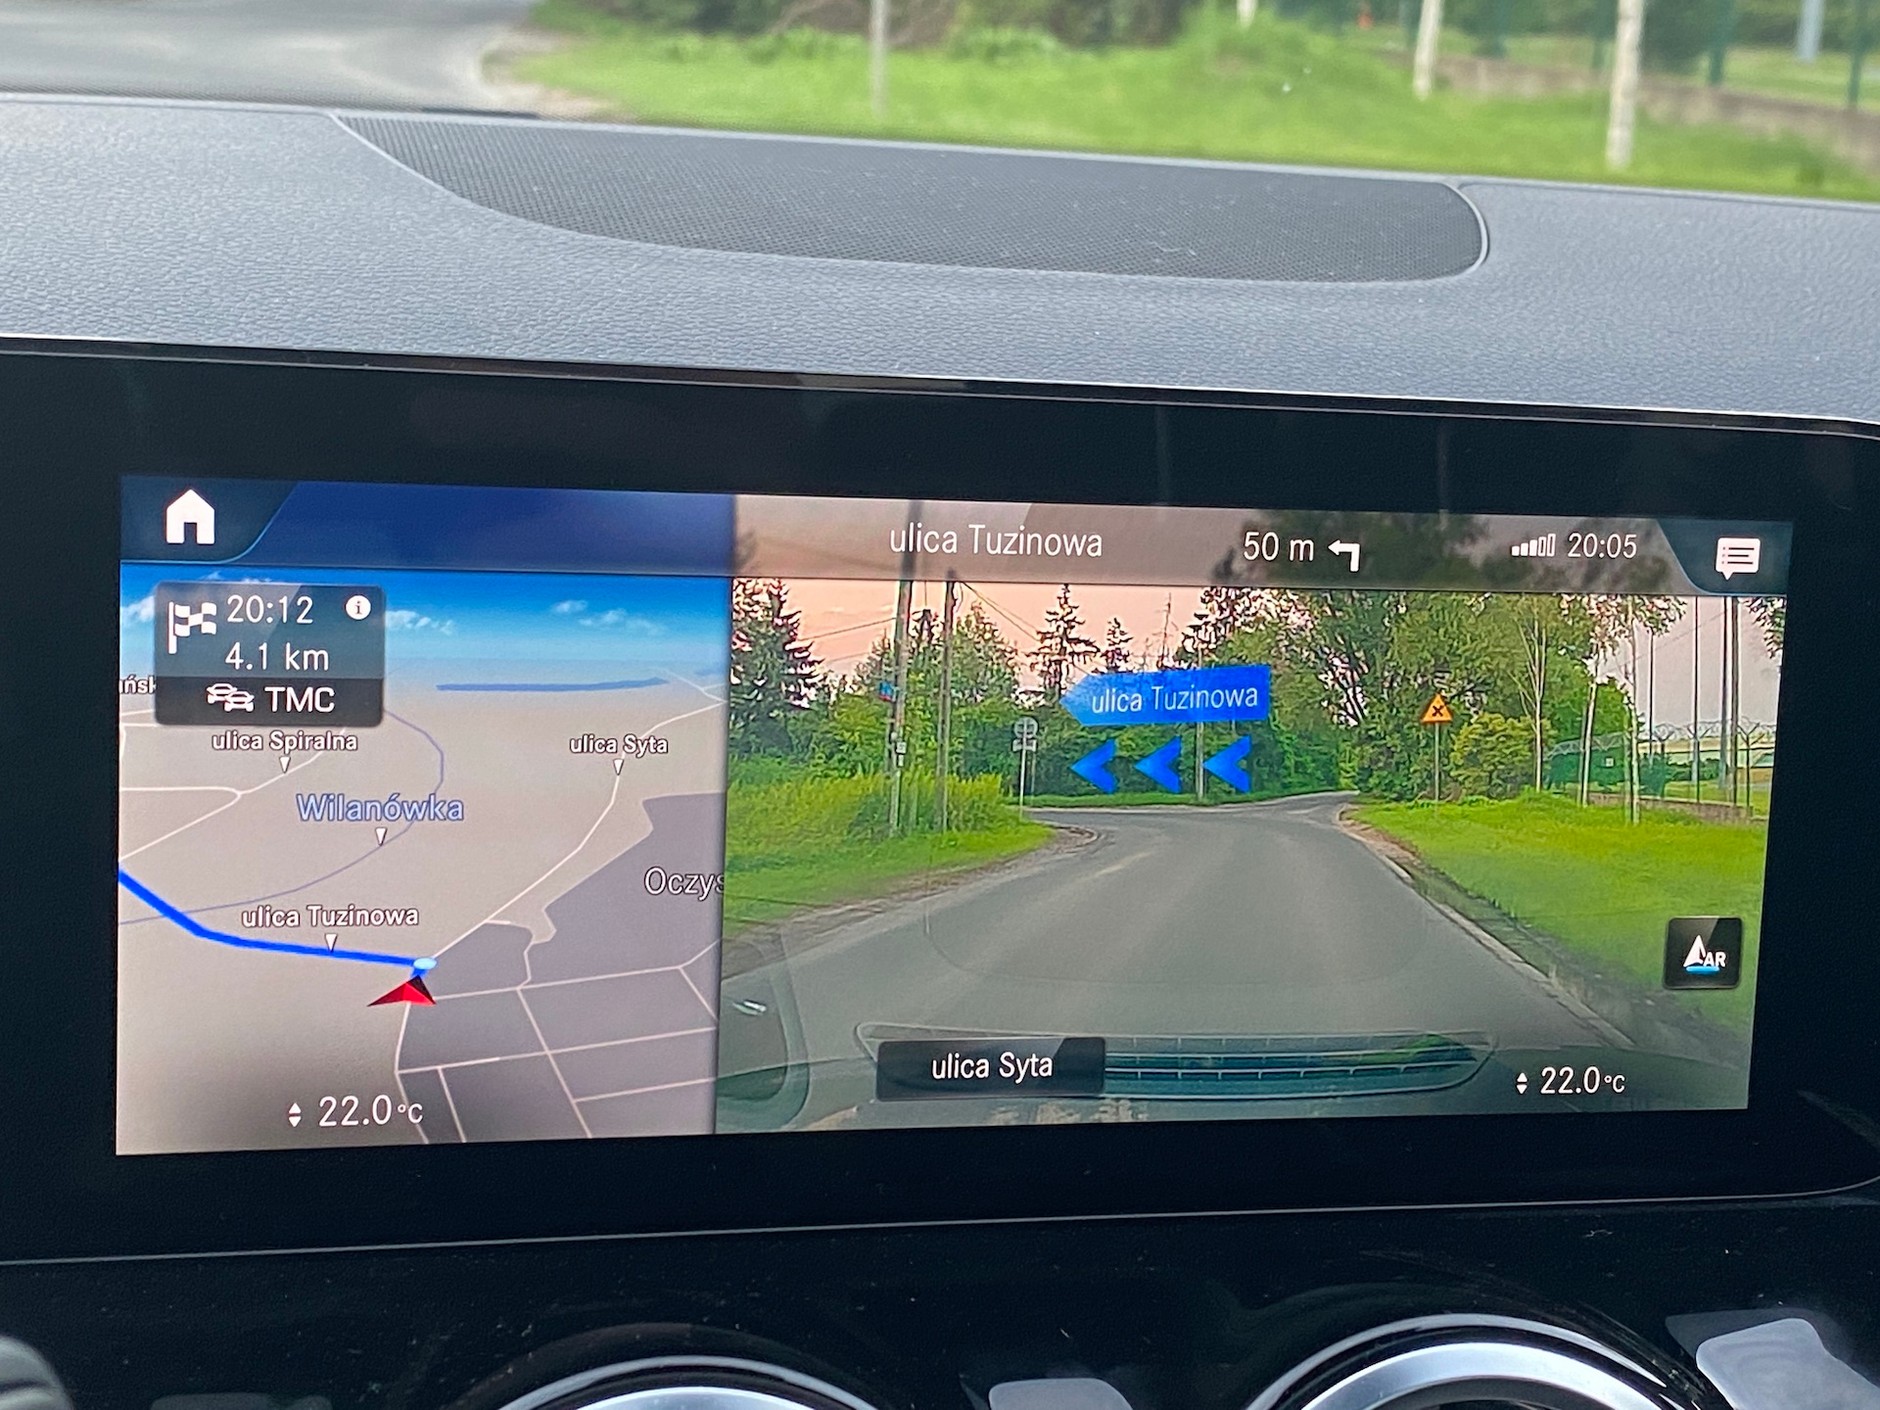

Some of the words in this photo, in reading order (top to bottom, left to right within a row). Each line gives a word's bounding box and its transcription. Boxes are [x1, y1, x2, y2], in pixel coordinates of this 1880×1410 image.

[890, 522, 957, 554] ulica
[968, 524, 1103, 557] Tuzinowa
[1243, 532, 1279, 562] 50
[1289, 538, 1315, 562] m
[1567, 532, 1638, 559] 20:05
[226, 595, 314, 624] 20:12
[225, 643, 270, 671] 4.1
[284, 642, 330, 671] km
[264, 686, 335, 713] TMC
[1091, 686, 1143, 713] ulica
[1152, 681, 1259, 711] Tuzinowa
[211, 731, 264, 751] ulica
[268, 731, 358, 756] Spiralna
[569, 734, 618, 754] ulica
[622, 735, 669, 759] Syta
[296, 794, 464, 822] Wilanówka
[241, 906, 300, 928] ulica
[307, 905, 419, 926] Tuzinowa
[1703, 950, 1726, 968] AR
[931, 1052, 990, 1080] ulica
[998, 1051, 1054, 1084] Syta
